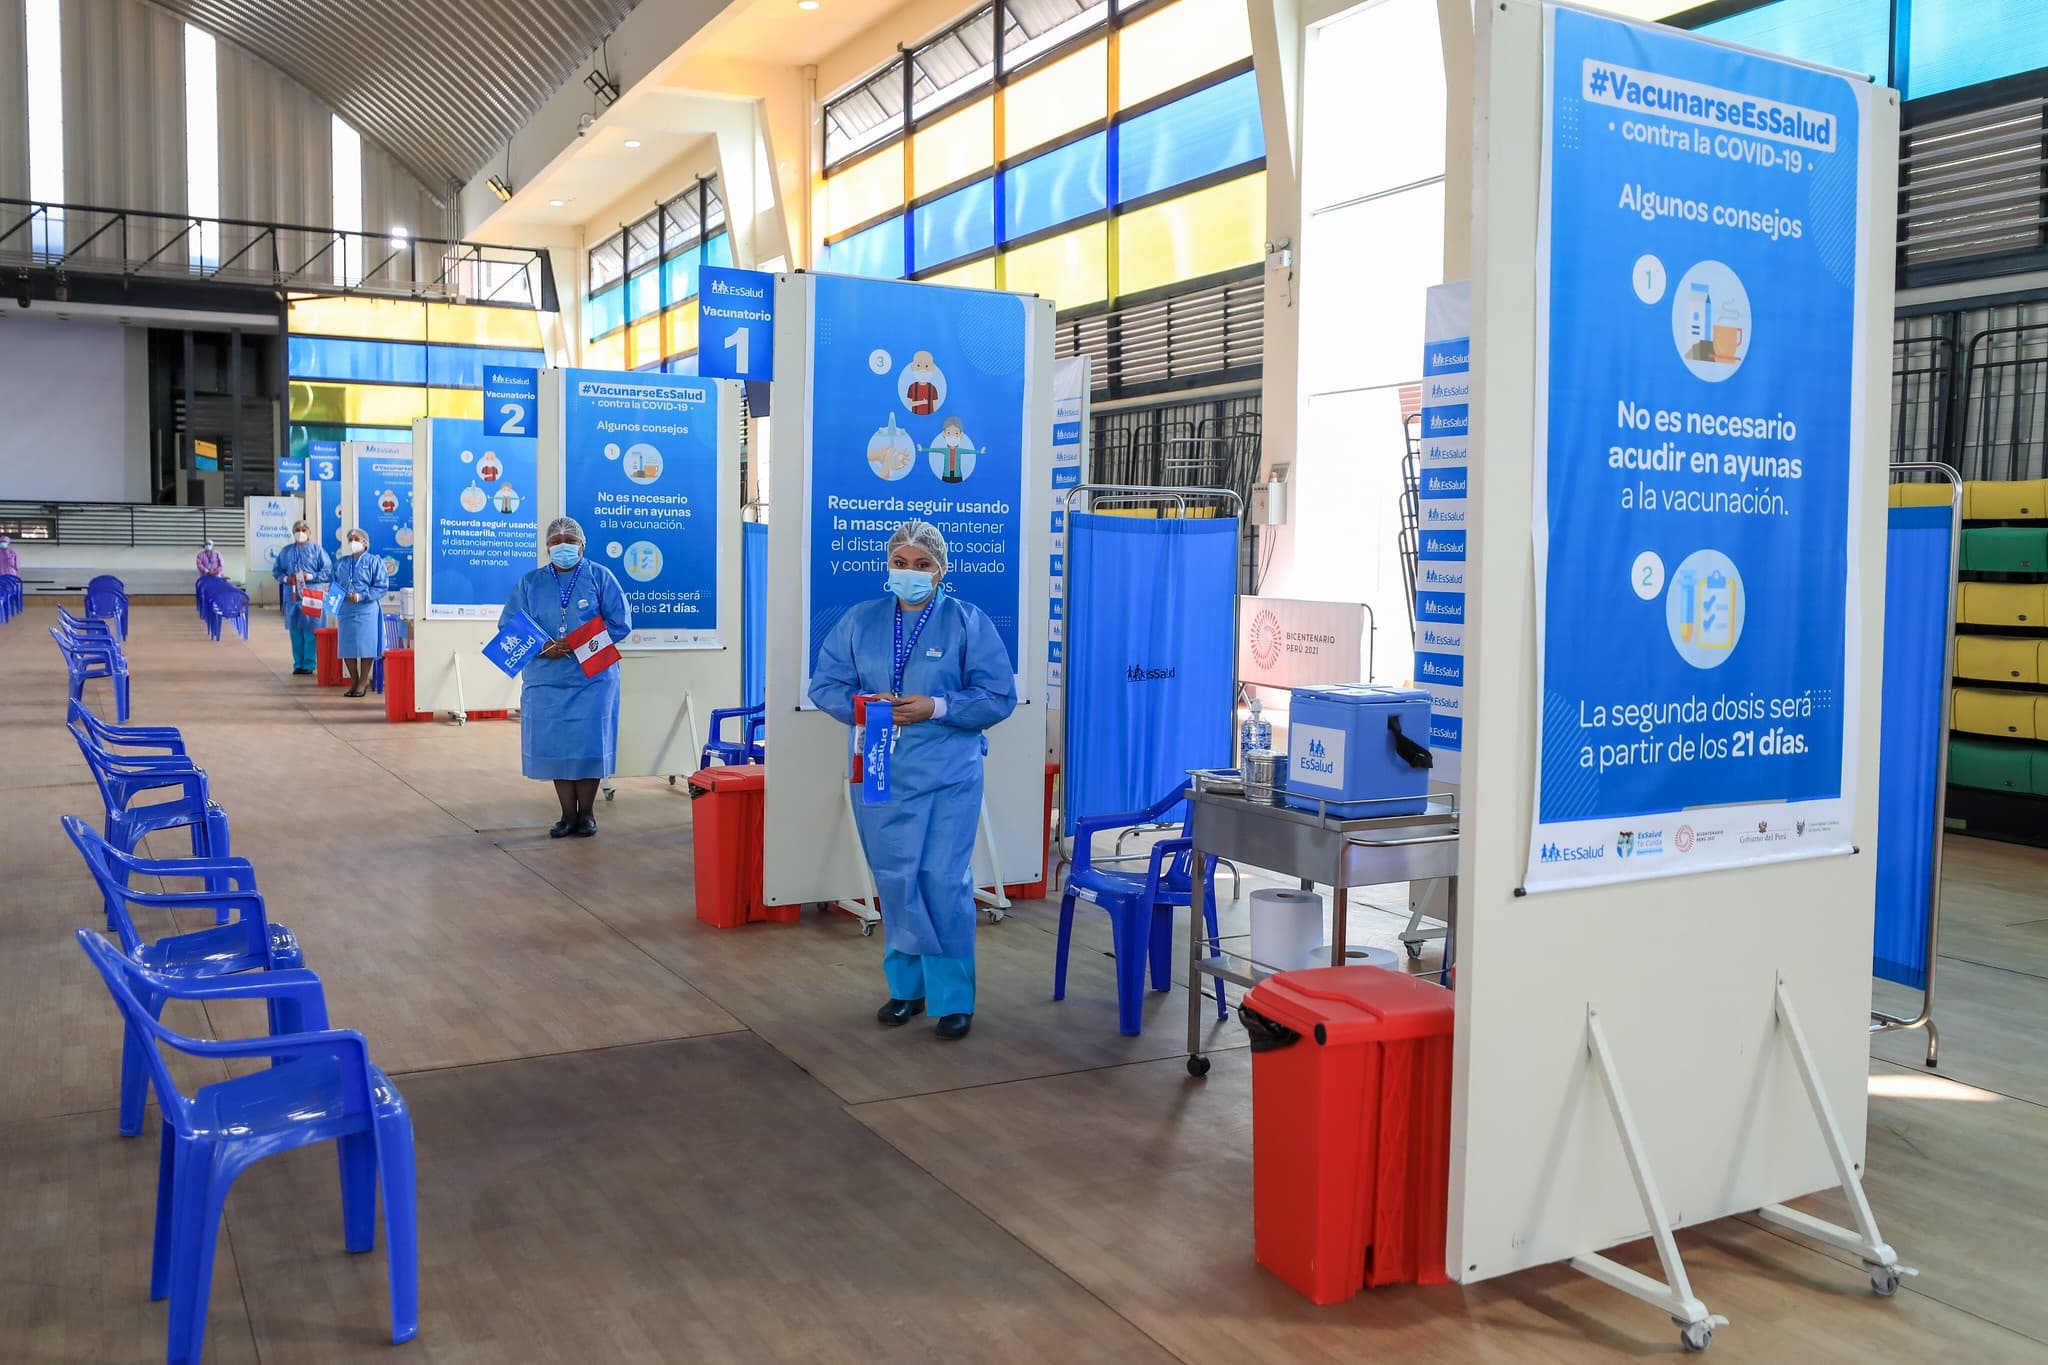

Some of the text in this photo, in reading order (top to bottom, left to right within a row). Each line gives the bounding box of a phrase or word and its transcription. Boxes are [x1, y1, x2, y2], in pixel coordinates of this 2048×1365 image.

[1589, 67, 1831, 145] #VacunarseEsSalud
[1621, 120, 1802, 174] contra la COVID-19
[1618, 183, 1803, 241] Algunos consejos
[1645, 269, 1653, 290] 1
[730, 286, 764, 298] EsSalud
[702, 305, 772, 321] Vacunatorio
[724, 326, 750, 375] 1
[876, 356, 885, 368] 3
[505, 377, 530, 385] EsSalud
[486, 390, 536, 400] Vacunatorio
[582, 384, 703, 401] #VacunarseEsSalud
[1444, 384, 1469, 396] EsSalud
[597, 399, 689, 412] contra la COVID-19
[500, 403, 525, 434] 2
[1443, 416, 1468, 428] EsSalud
[1617, 401, 1797, 442] No es necesario
[597, 420, 689, 436] Algunos consejos
[1442, 447, 1467, 459] EsSalud
[1608, 442, 1803, 480] acudir en ayunas
[319, 461, 335, 481] 3
[285, 474, 301, 491] 4
[1441, 478, 1466, 490] EsSalud
[598, 492, 688, 504] No es necesario
[1621, 481, 1790, 517] a la vacunación.
[594, 505, 691, 519] acudir en ayunas
[827, 495, 1010, 516] Recuerda seguir usando
[1440, 510, 1465, 522] EsSalud
[440, 518, 481, 528] Recuerda
[482, 520, 508, 530] seguir
[600, 519, 686, 531] a la vacunación.
[833, 515, 848, 531] la
[937, 520, 1005, 535] mantener
[443, 527, 536, 539] la mascarilla, mantener
[441, 537, 537, 548] el distanciamiento social
[831, 536, 844, 551] el
[966, 540, 1005, 554] social
[1439, 542, 1464, 553] EsSalud
[441, 548, 447, 557] y
[447, 547, 486, 556] continuar
[503, 549, 511, 557] el
[511, 549, 537, 558] lavado
[469, 558, 480, 567] de
[830, 561, 839, 576] y
[960, 559, 1005, 574] lavado
[1438, 573, 1463, 584] EsSalud
[1641, 566, 1654, 586] 2
[647, 589, 676, 600] dosis
[677, 589, 701, 600] será
[641, 603, 657, 614] los
[659, 603, 670, 613] 21
[673, 603, 700, 614] días.
[1437, 604, 1462, 616] EsSalud
[1286, 631, 1336, 645] BICENTENARIO
[1436, 635, 1461, 647] EsSalud
[504, 634, 537, 669] EsSalud
[1304, 645, 1319, 655] 2021
[1435, 666, 1460, 678] EsSalud
[1434, 697, 1459, 709] EsSalud
[1579, 690, 1812, 733] La segunda dosis será
[1433, 728, 1458, 740] EsSalud
[1579, 728, 1810, 775] a partir de los 21 días.
[877, 728, 889, 791] EsSalud
[1300, 756, 1334, 774] EsSalud
[1562, 844, 1604, 861] EsSalud
